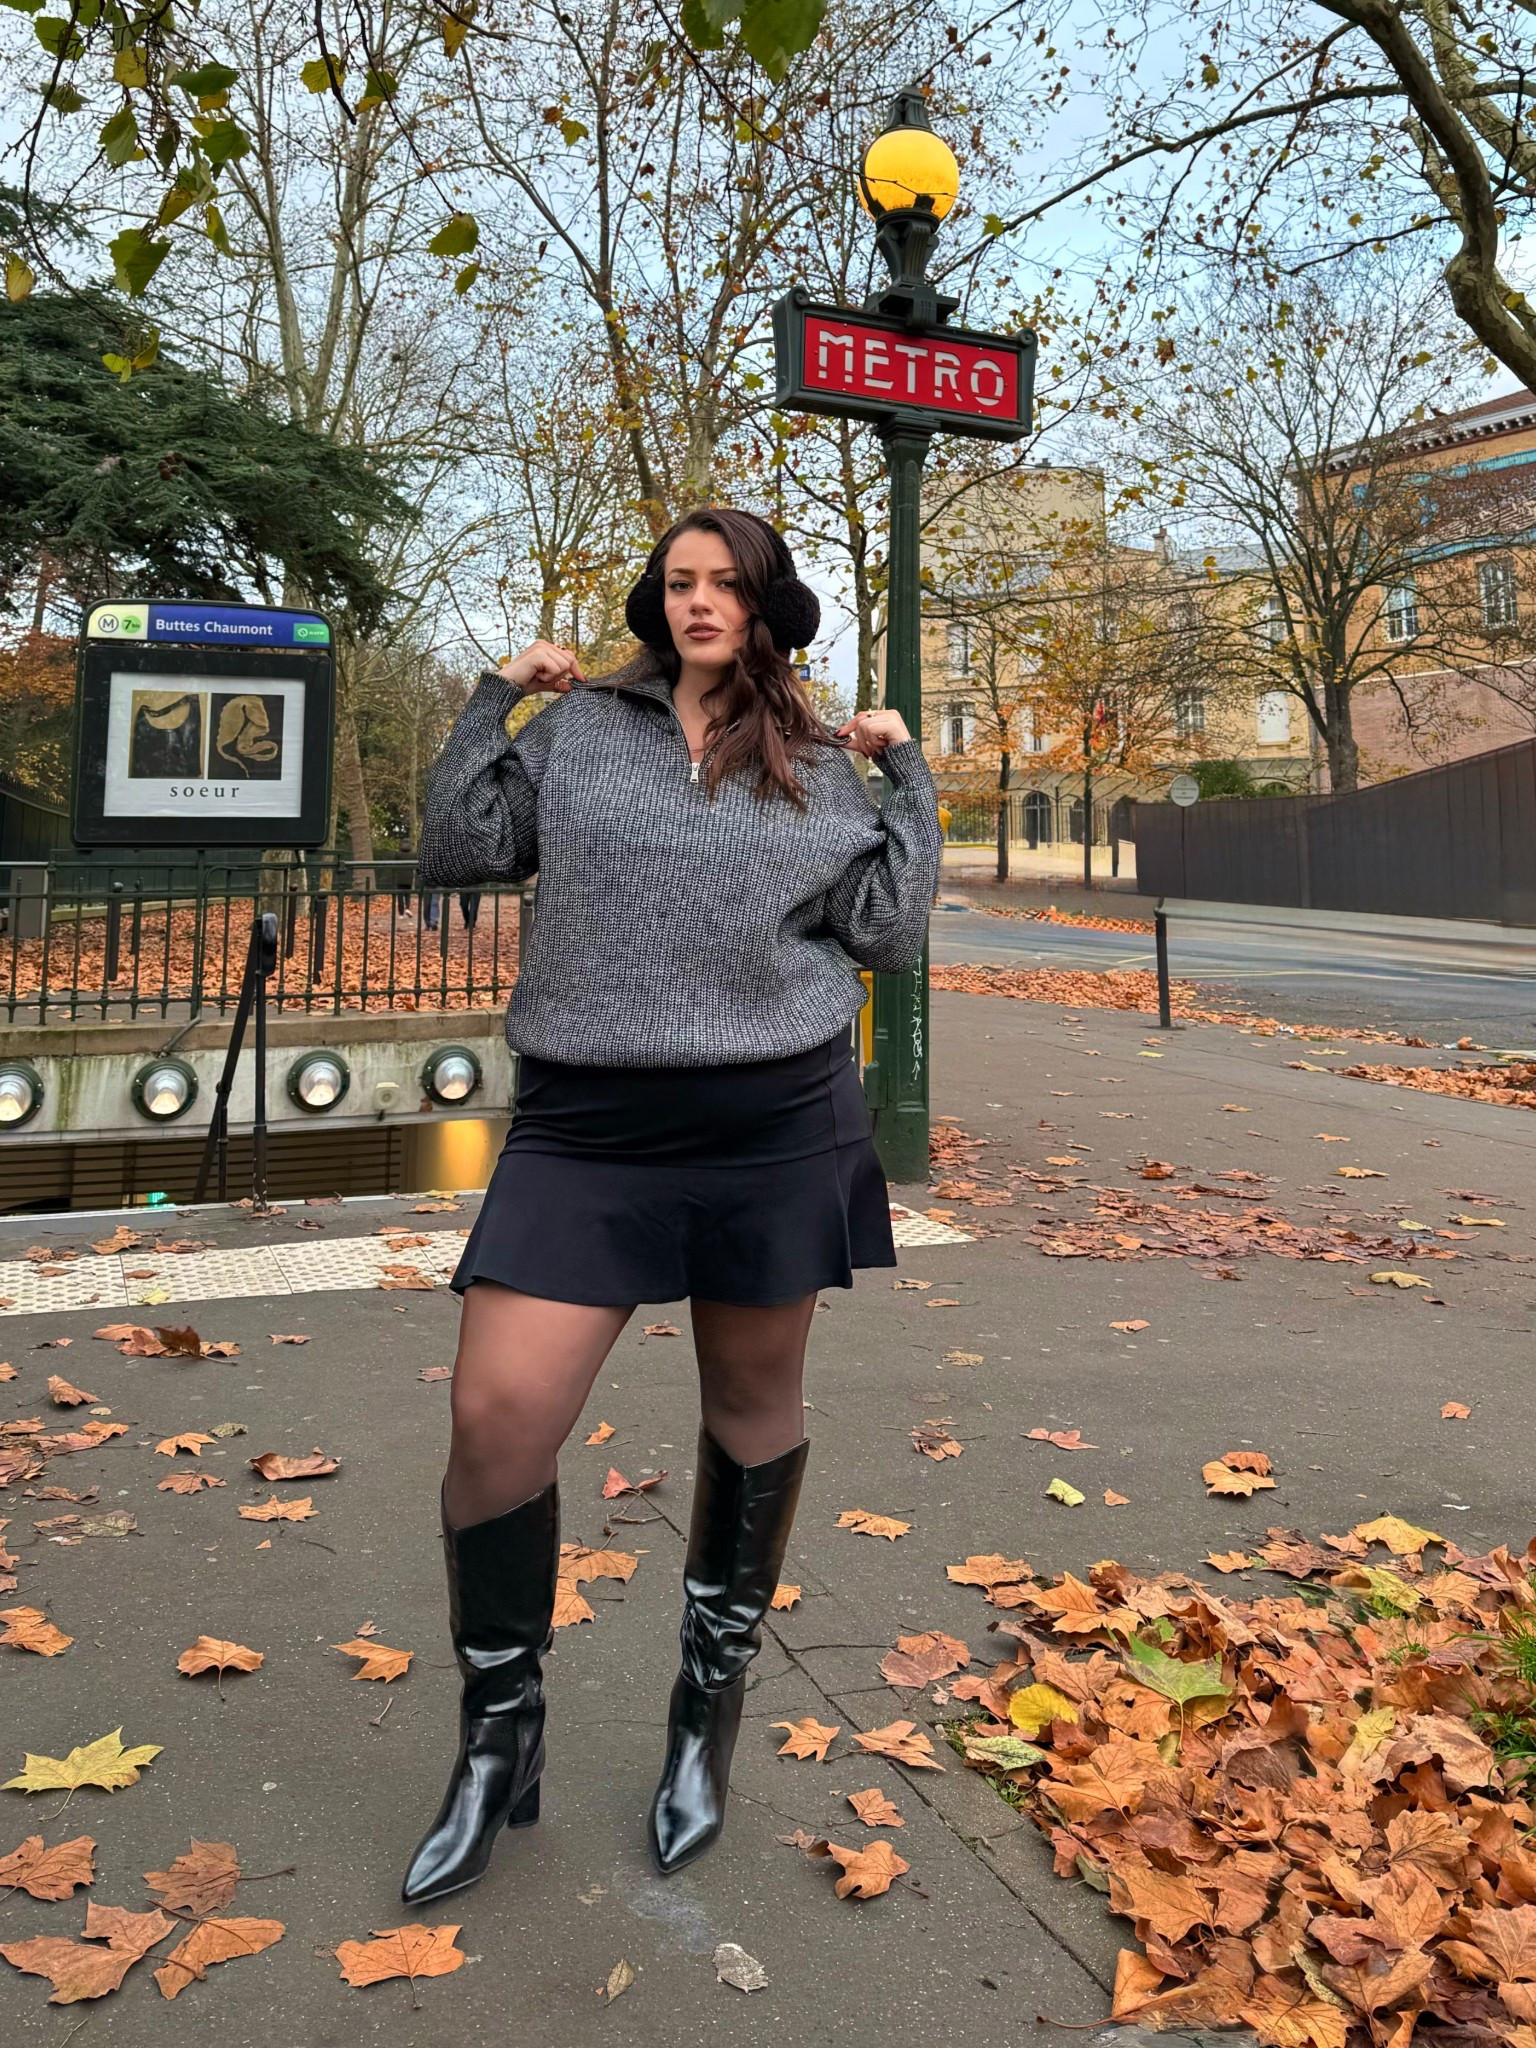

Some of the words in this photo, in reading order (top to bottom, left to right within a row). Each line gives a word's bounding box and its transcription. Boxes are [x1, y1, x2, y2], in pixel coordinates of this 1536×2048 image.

[818, 330, 1004, 406] METRO
[155, 619, 200, 632] Buttes
[204, 621, 273, 636] Chaumont
[169, 786, 240, 798] soeur
